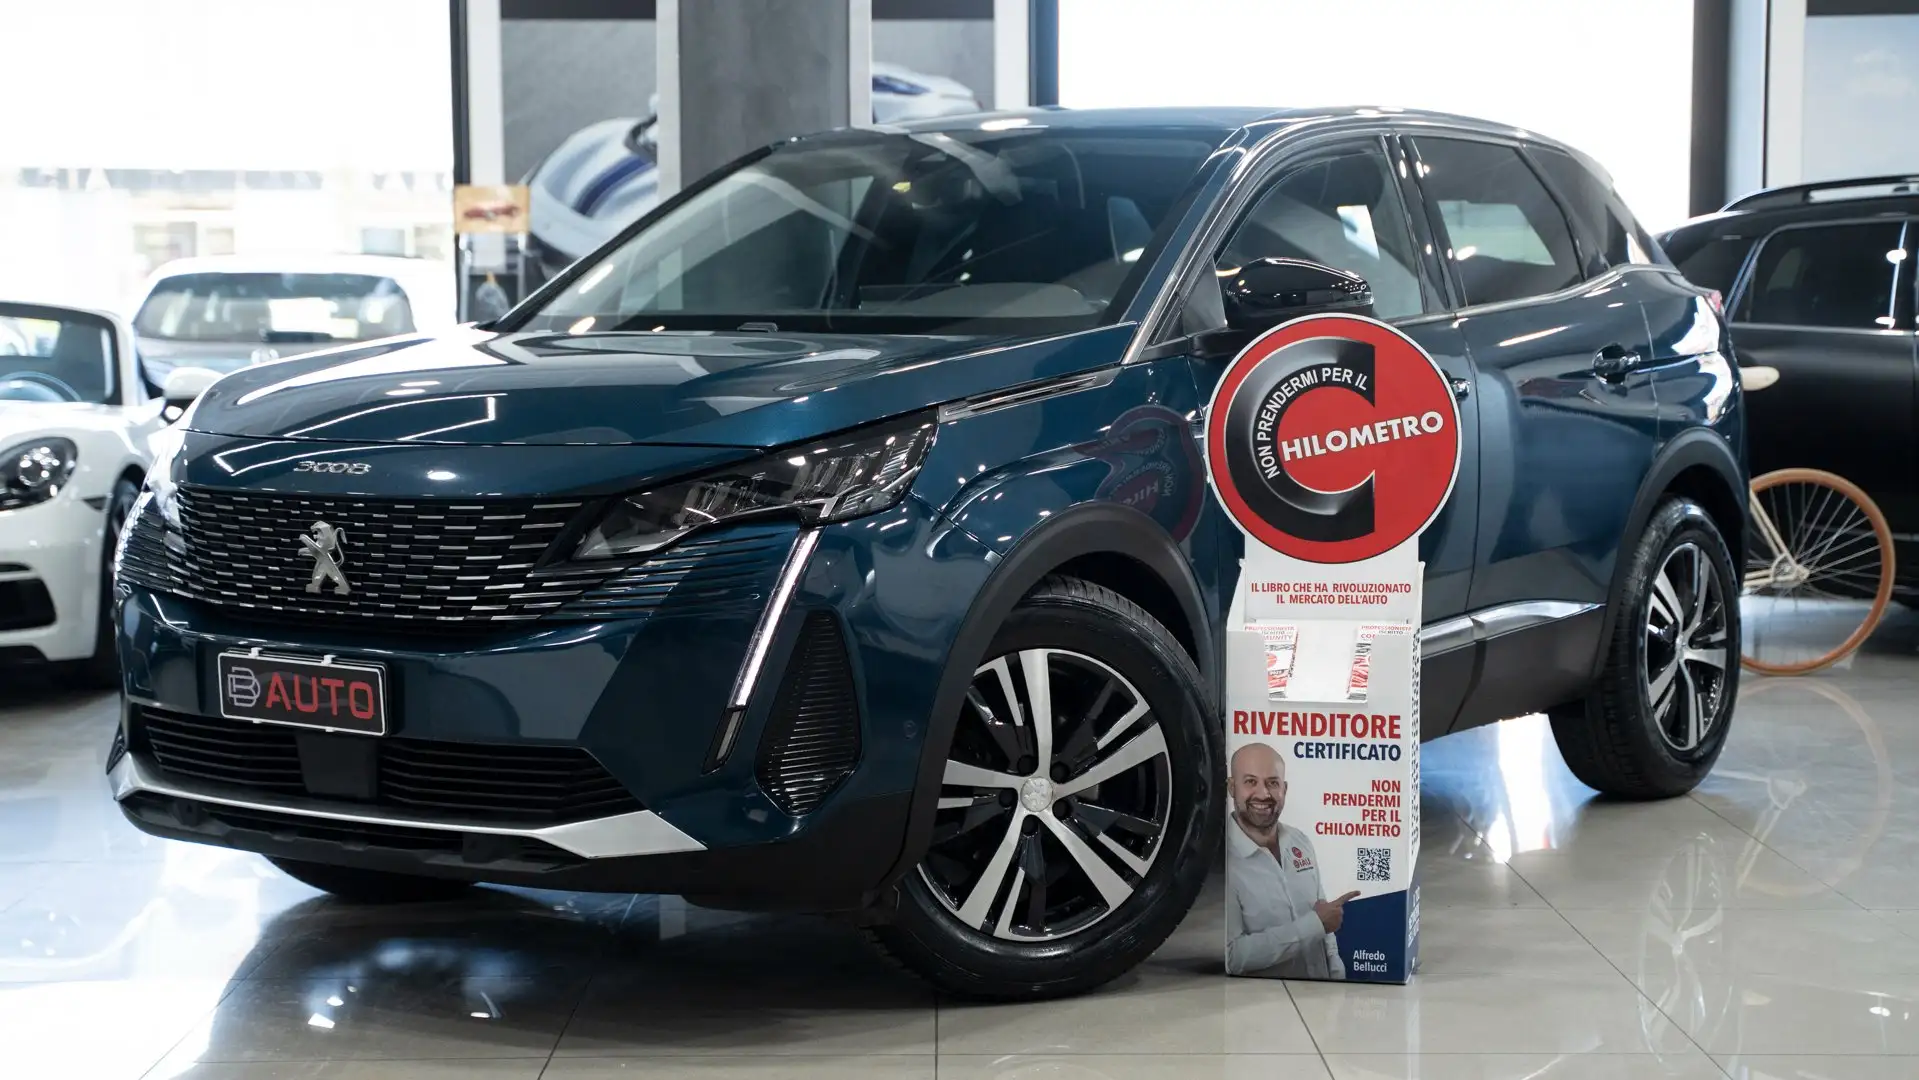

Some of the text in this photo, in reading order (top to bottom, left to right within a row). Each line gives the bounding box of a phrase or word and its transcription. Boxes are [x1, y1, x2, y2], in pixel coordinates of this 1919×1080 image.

[1257, 367, 1368, 479] NON PRENDERMI PER IL
[293, 460, 372, 475] 3008
[1251, 583, 1412, 593] IL LIBRO CHE HA RIVOLUZIONATO
[1276, 594, 1388, 605] IL MERCATO DELL'AUTO
[265, 671, 375, 720] AUTO
[1233, 710, 1401, 739] RIVENDITORE
[1293, 741, 1401, 761] CERTIFICATO
[1371, 779, 1401, 793] NON
[1323, 793, 1401, 808] PRENDERMI
[1362, 809, 1402, 823] PER IL
[1315, 822, 1401, 837] CHILOMETRO
[1353, 949, 1386, 961] Alfredo
[1353, 961, 1387, 973] Bellucci
